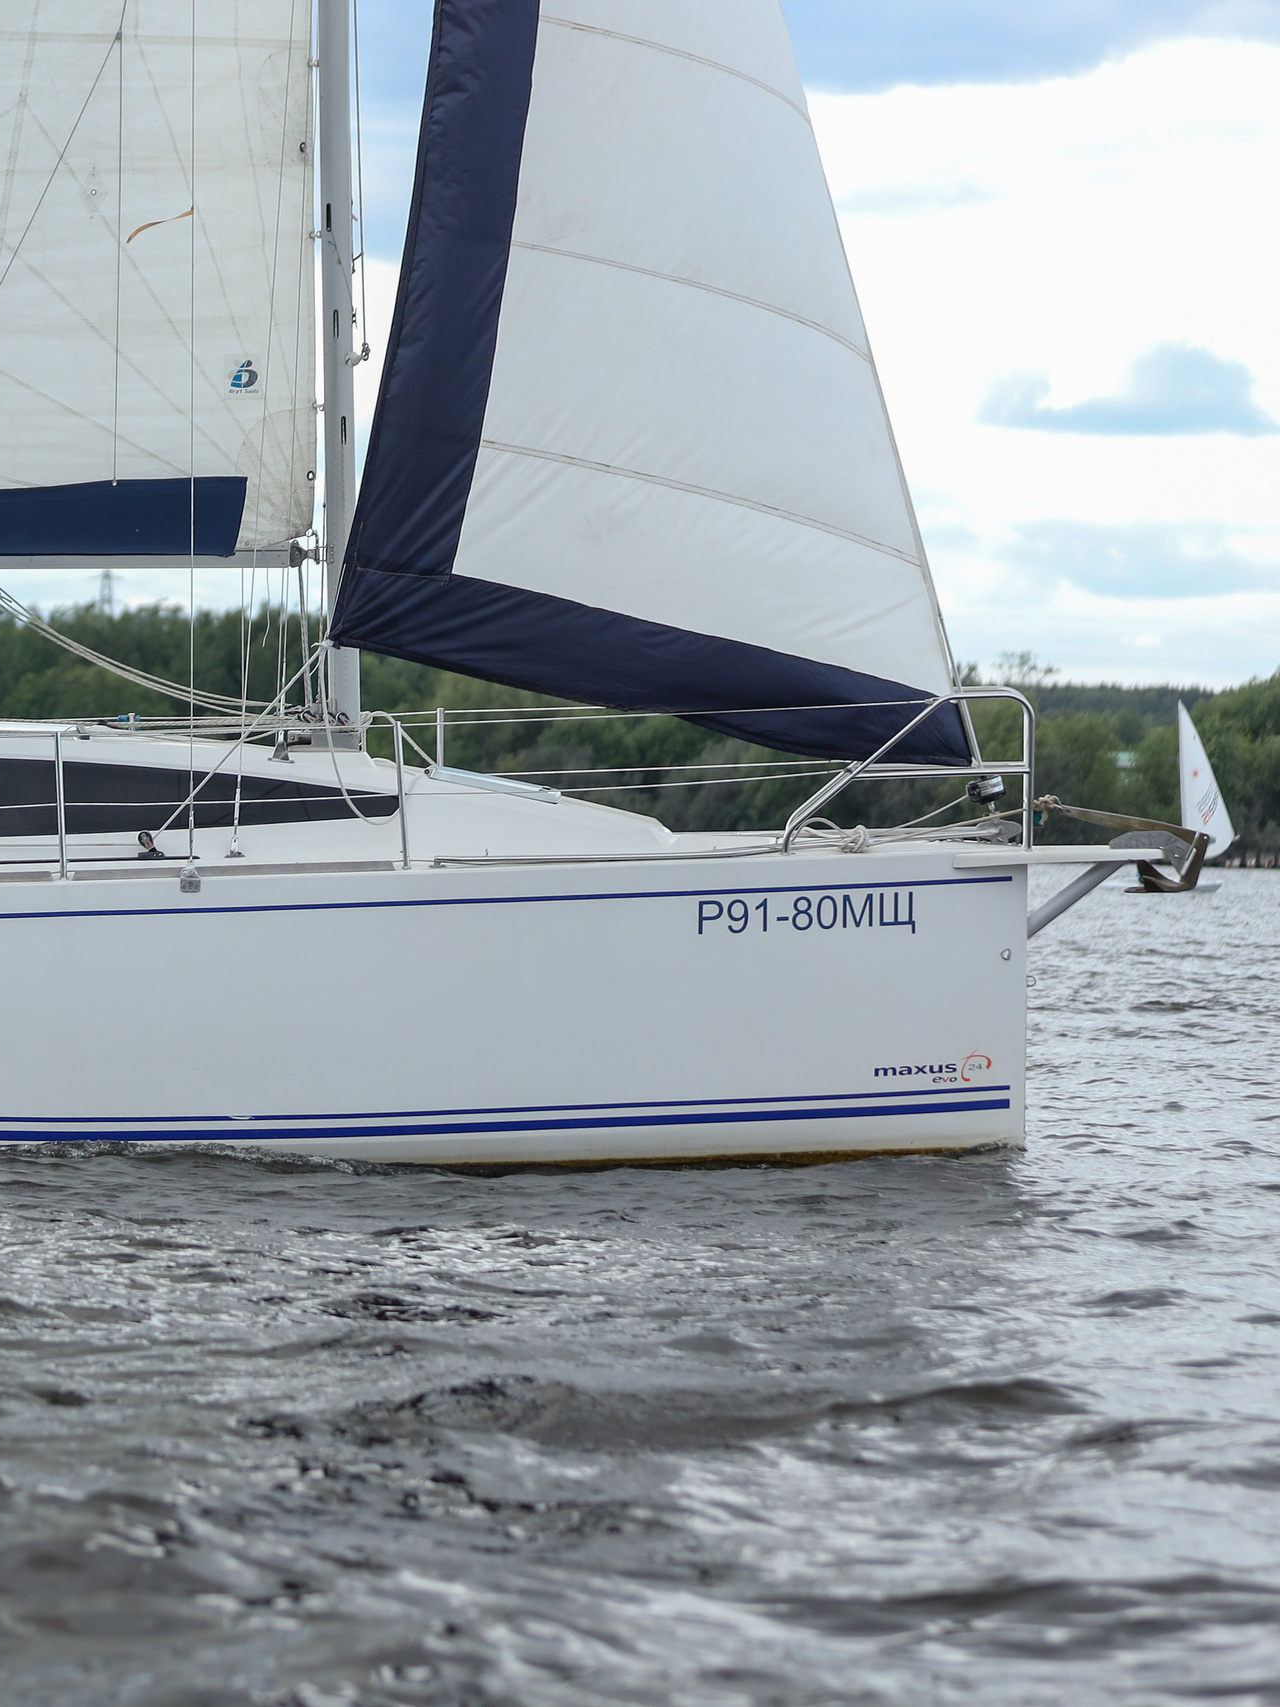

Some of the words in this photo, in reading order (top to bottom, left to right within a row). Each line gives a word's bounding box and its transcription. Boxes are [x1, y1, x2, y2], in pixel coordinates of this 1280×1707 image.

[696, 891, 916, 935] Р91-80МЩ
[873, 1063, 958, 1077] maxus
[968, 1063, 983, 1071] 24
[932, 1075, 958, 1084] evo
